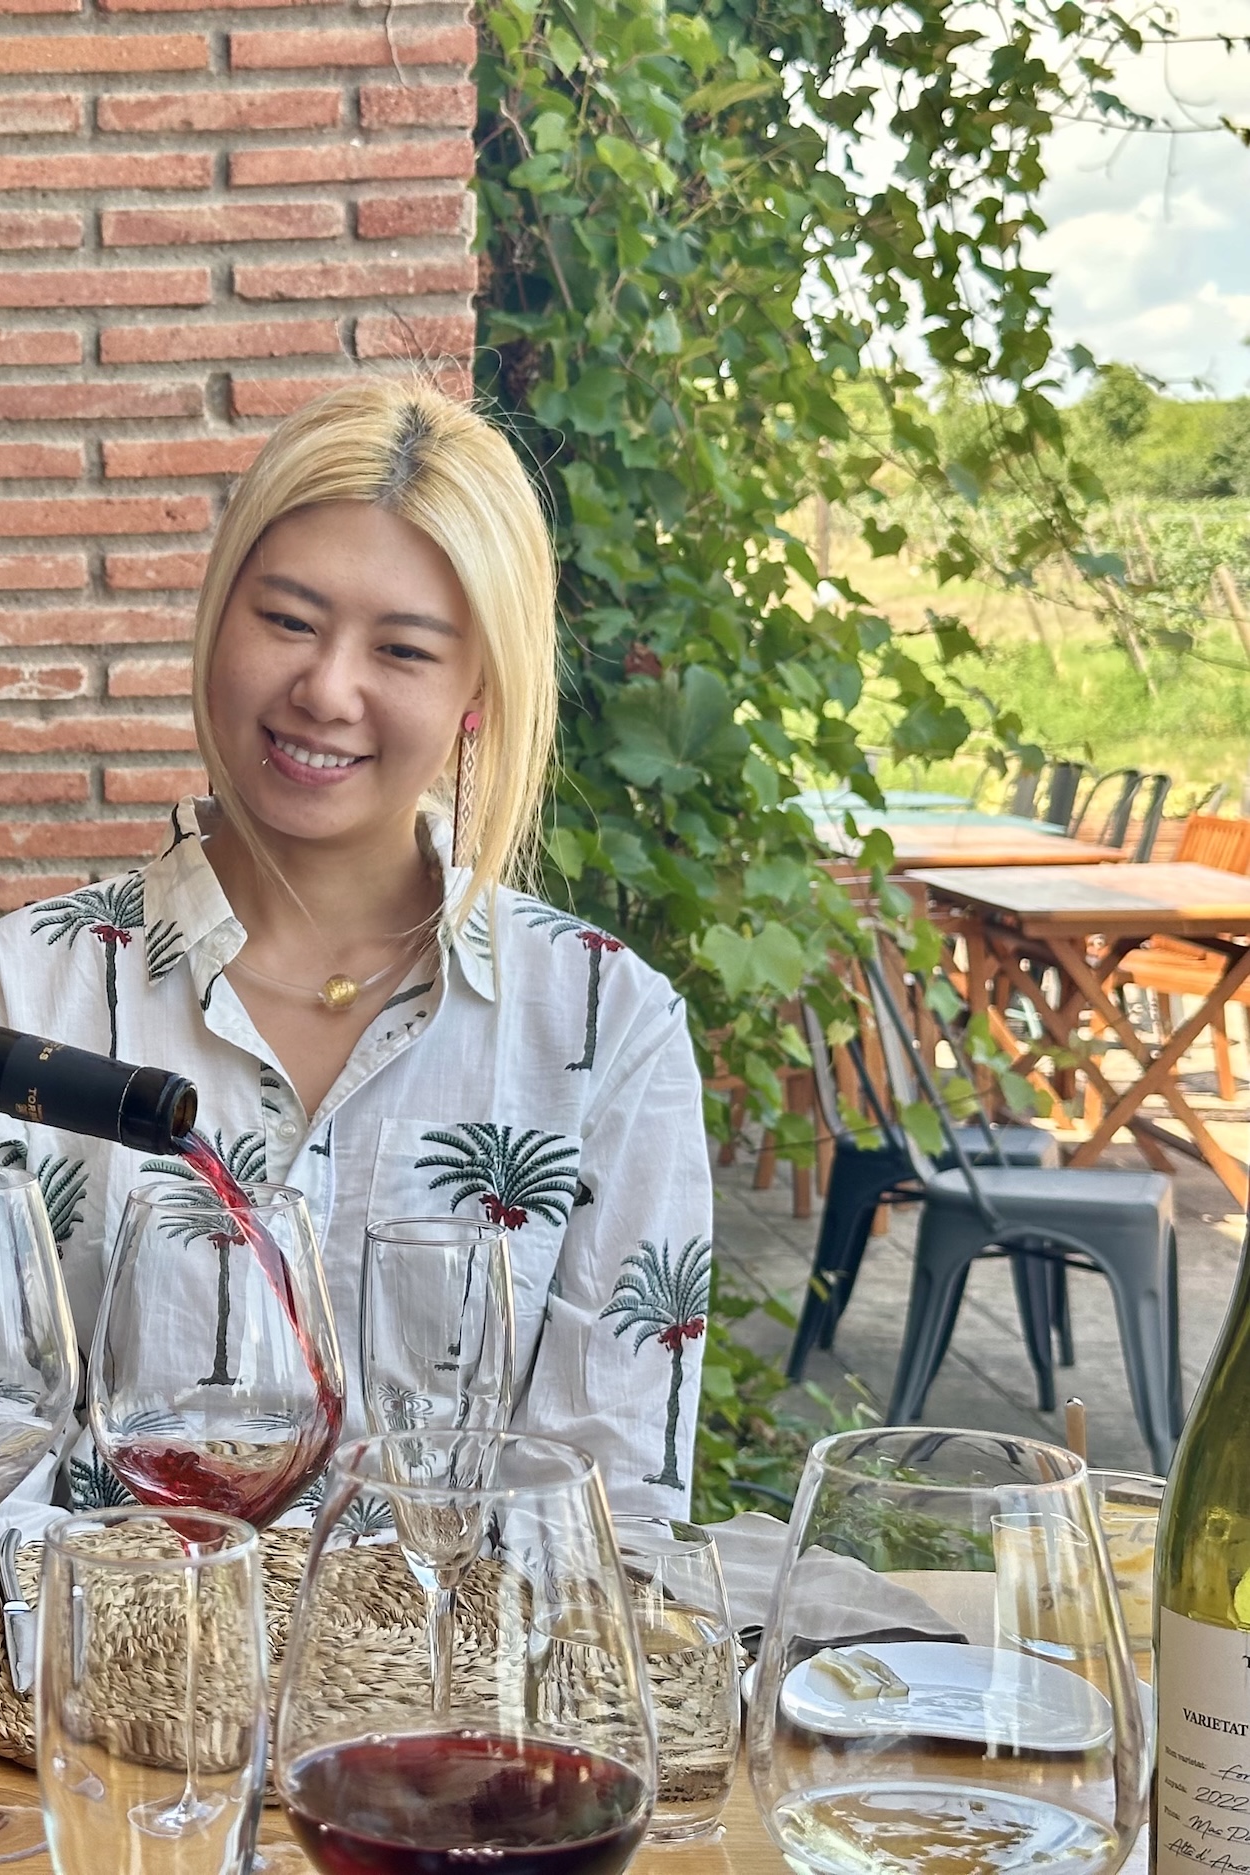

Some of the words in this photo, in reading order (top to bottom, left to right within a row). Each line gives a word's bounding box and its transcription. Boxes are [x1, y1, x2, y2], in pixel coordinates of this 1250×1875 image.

[1182, 1707, 1249, 1736] VARIETAT
[1195, 1786, 1249, 1811] 2022
[1189, 1815, 1224, 1840] Mas
